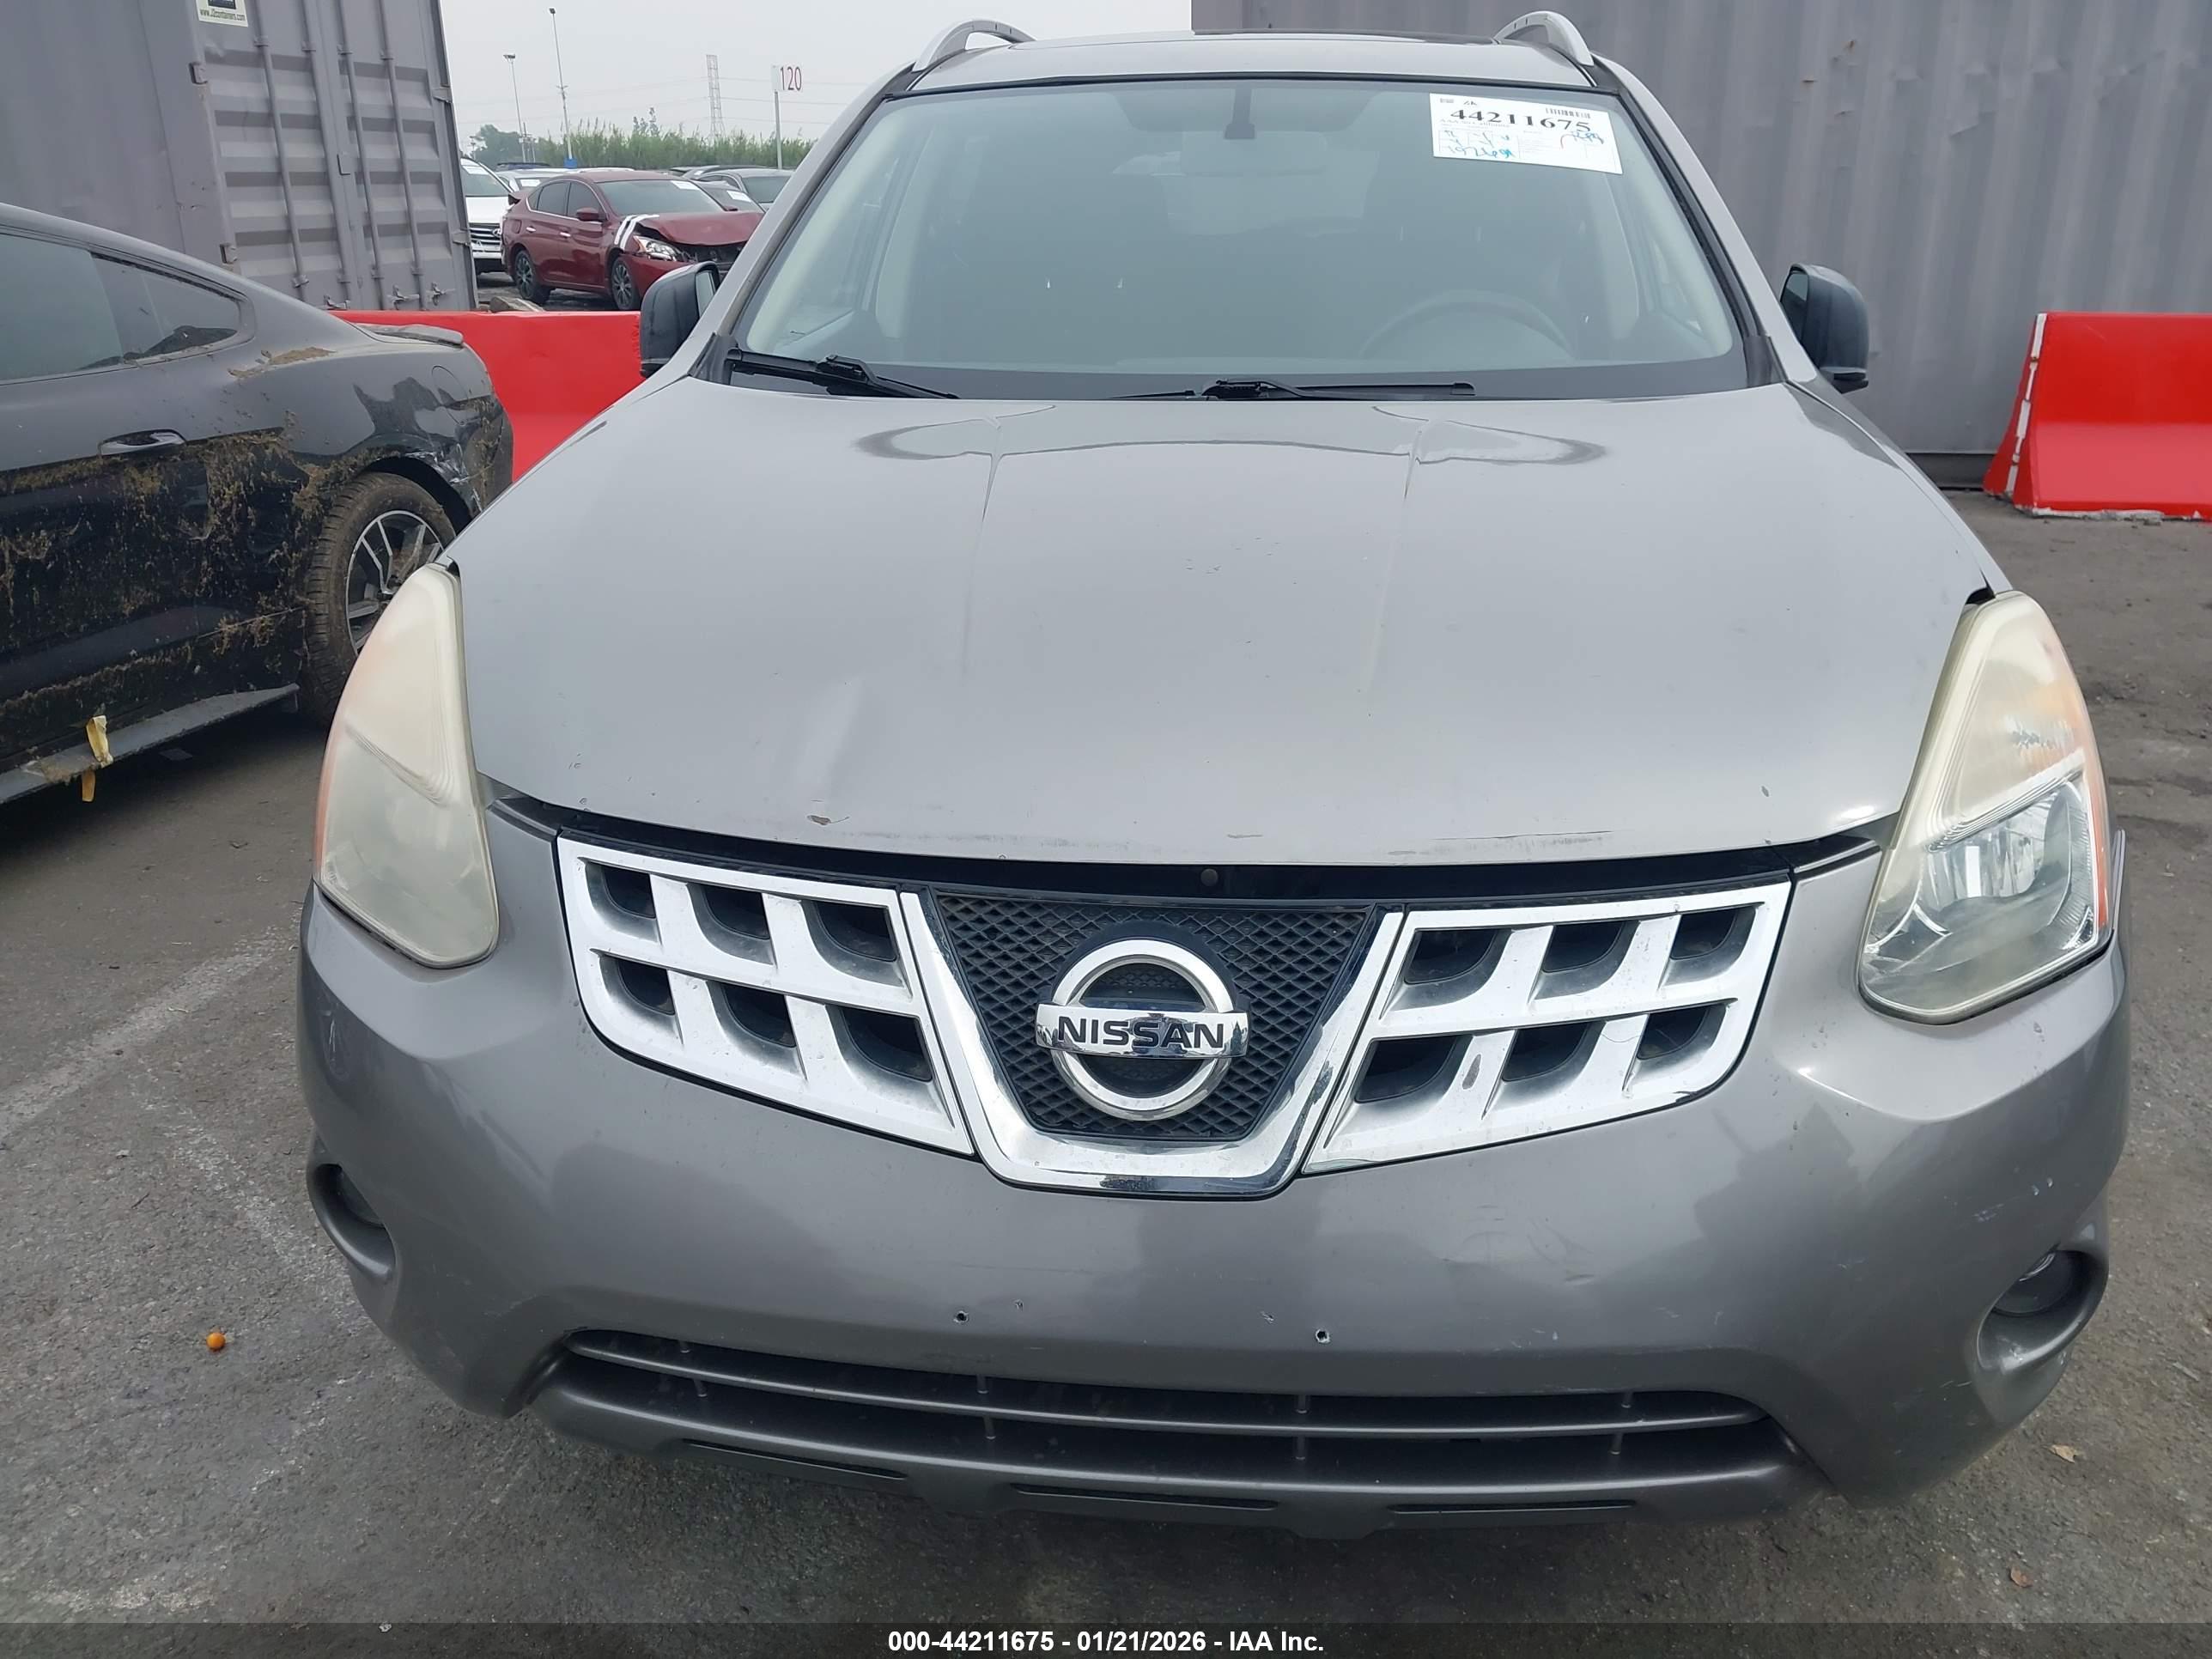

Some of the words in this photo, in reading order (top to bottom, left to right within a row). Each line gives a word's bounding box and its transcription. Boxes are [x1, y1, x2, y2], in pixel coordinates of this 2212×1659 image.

[780, 66, 802, 91] 120
[1449, 108, 1591, 132] 44211675
[1057, 1016, 1224, 1049] NISSAN
